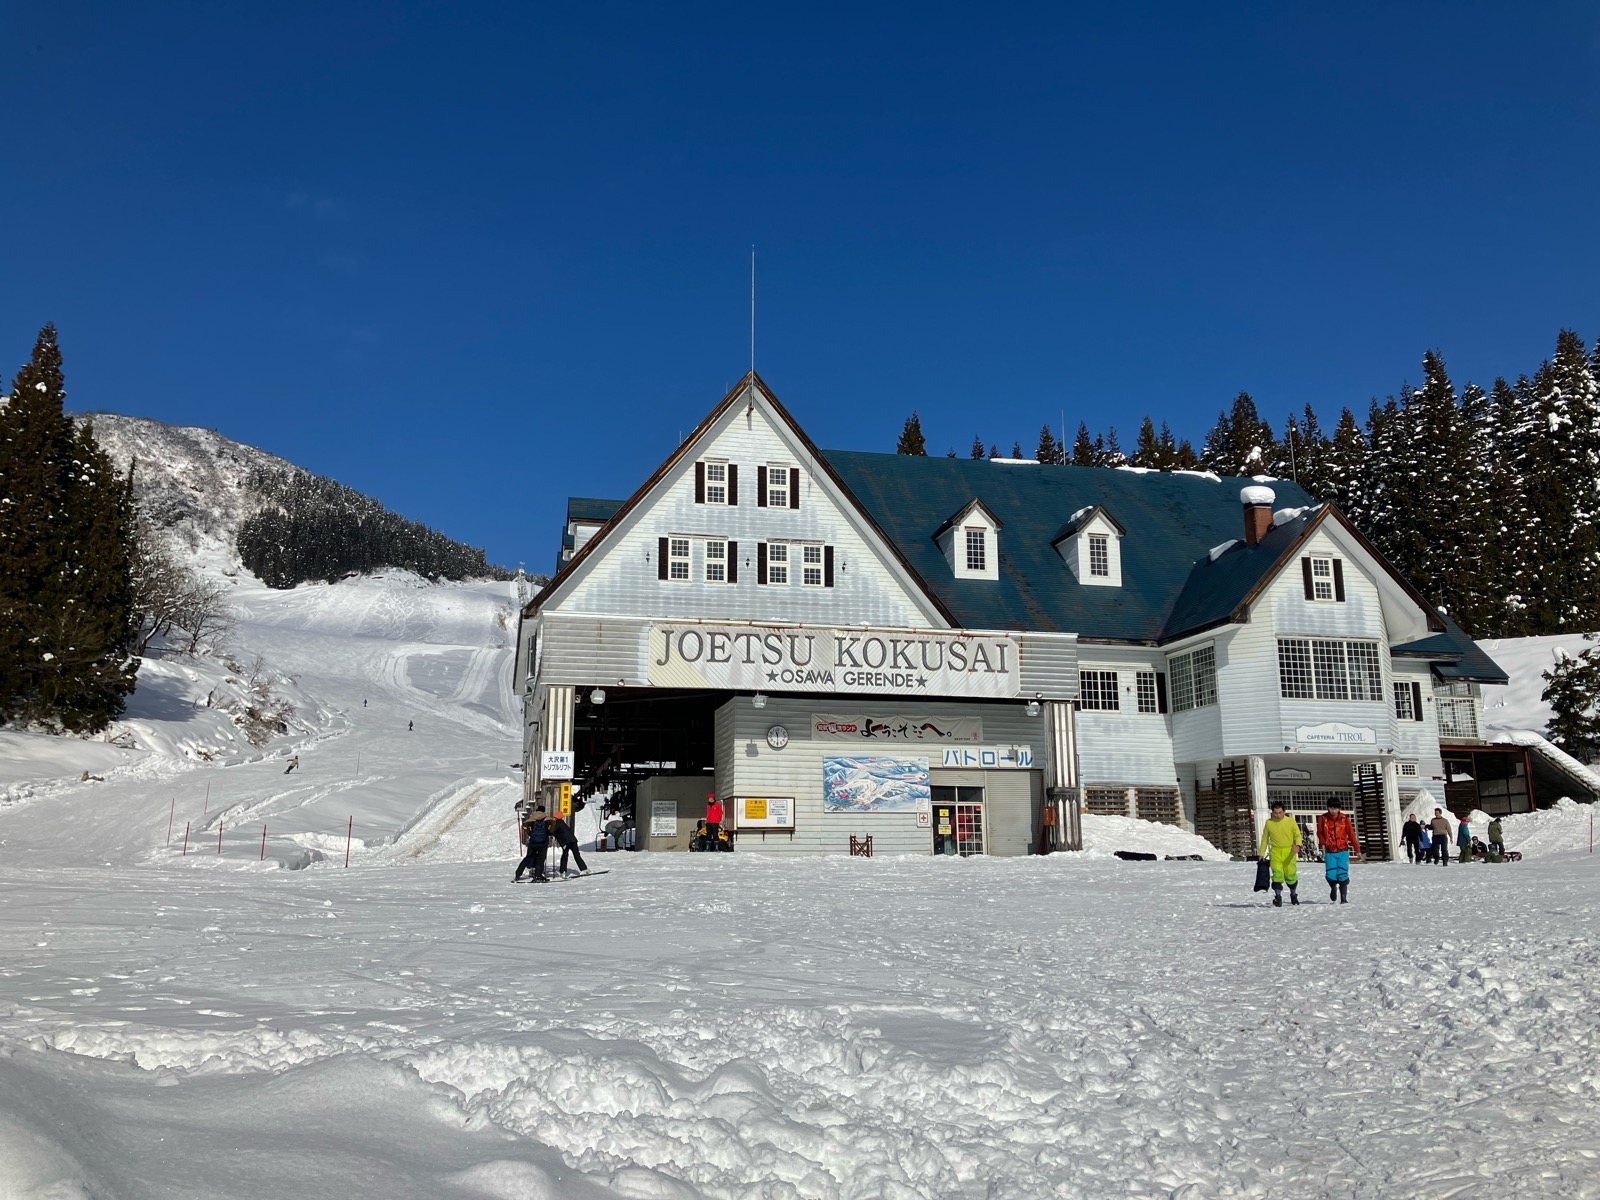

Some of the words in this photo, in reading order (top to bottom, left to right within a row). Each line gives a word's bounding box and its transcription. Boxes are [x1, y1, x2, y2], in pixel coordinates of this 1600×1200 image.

[656, 629, 815, 667] JOETSU
[834, 636, 1009, 674] KOKUSAI
[780, 668, 835, 685] OSAWA
[843, 671, 914, 688] GERENDE
[1337, 732, 1366, 742] TIROL
[944, 749, 1033, 766] パトロール
